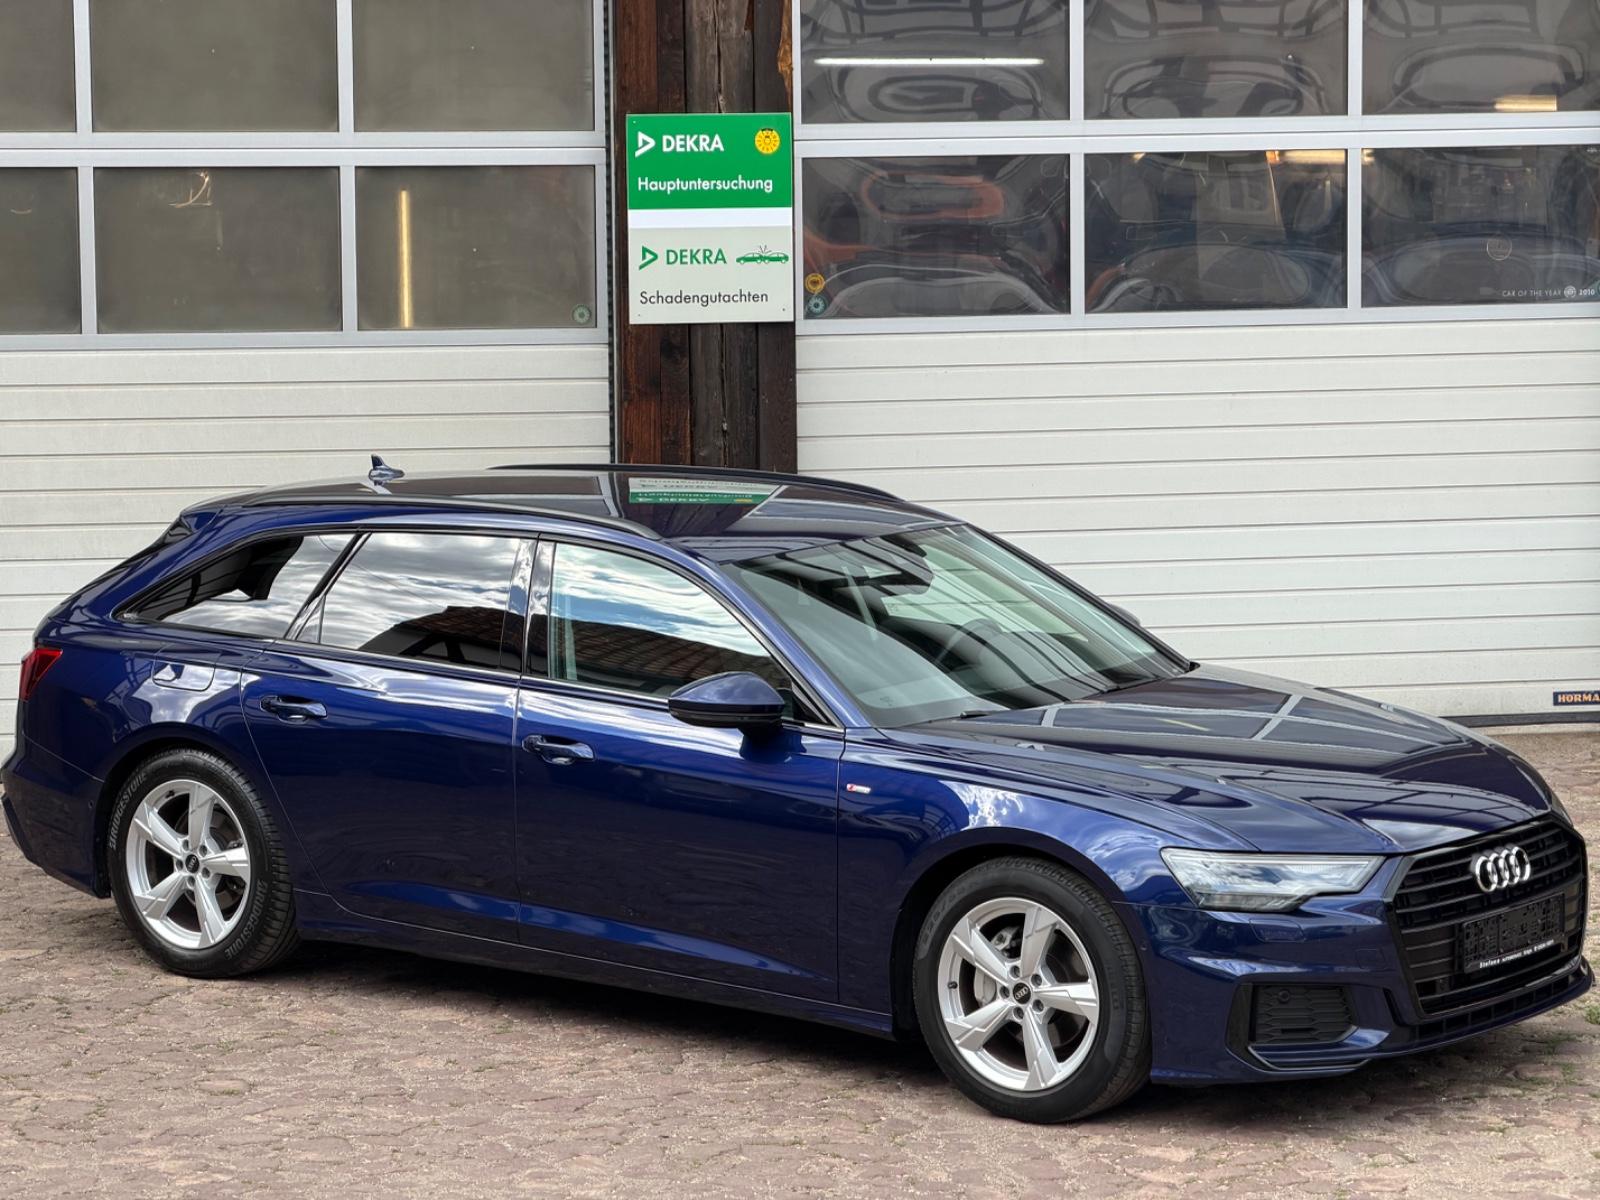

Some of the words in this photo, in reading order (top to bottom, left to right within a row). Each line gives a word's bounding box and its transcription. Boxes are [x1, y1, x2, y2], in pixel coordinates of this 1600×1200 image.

[662, 134, 724, 152] DEKRA
[638, 174, 773, 194] Hauptuntersuchung
[666, 248, 727, 265] DEKRA
[640, 289, 769, 307] Schadengutachten
[1502, 289, 1516, 297] CAR
[1518, 289, 1528, 297] OF
[1530, 288, 1543, 297] THE
[1545, 288, 1562, 297] YEAR
